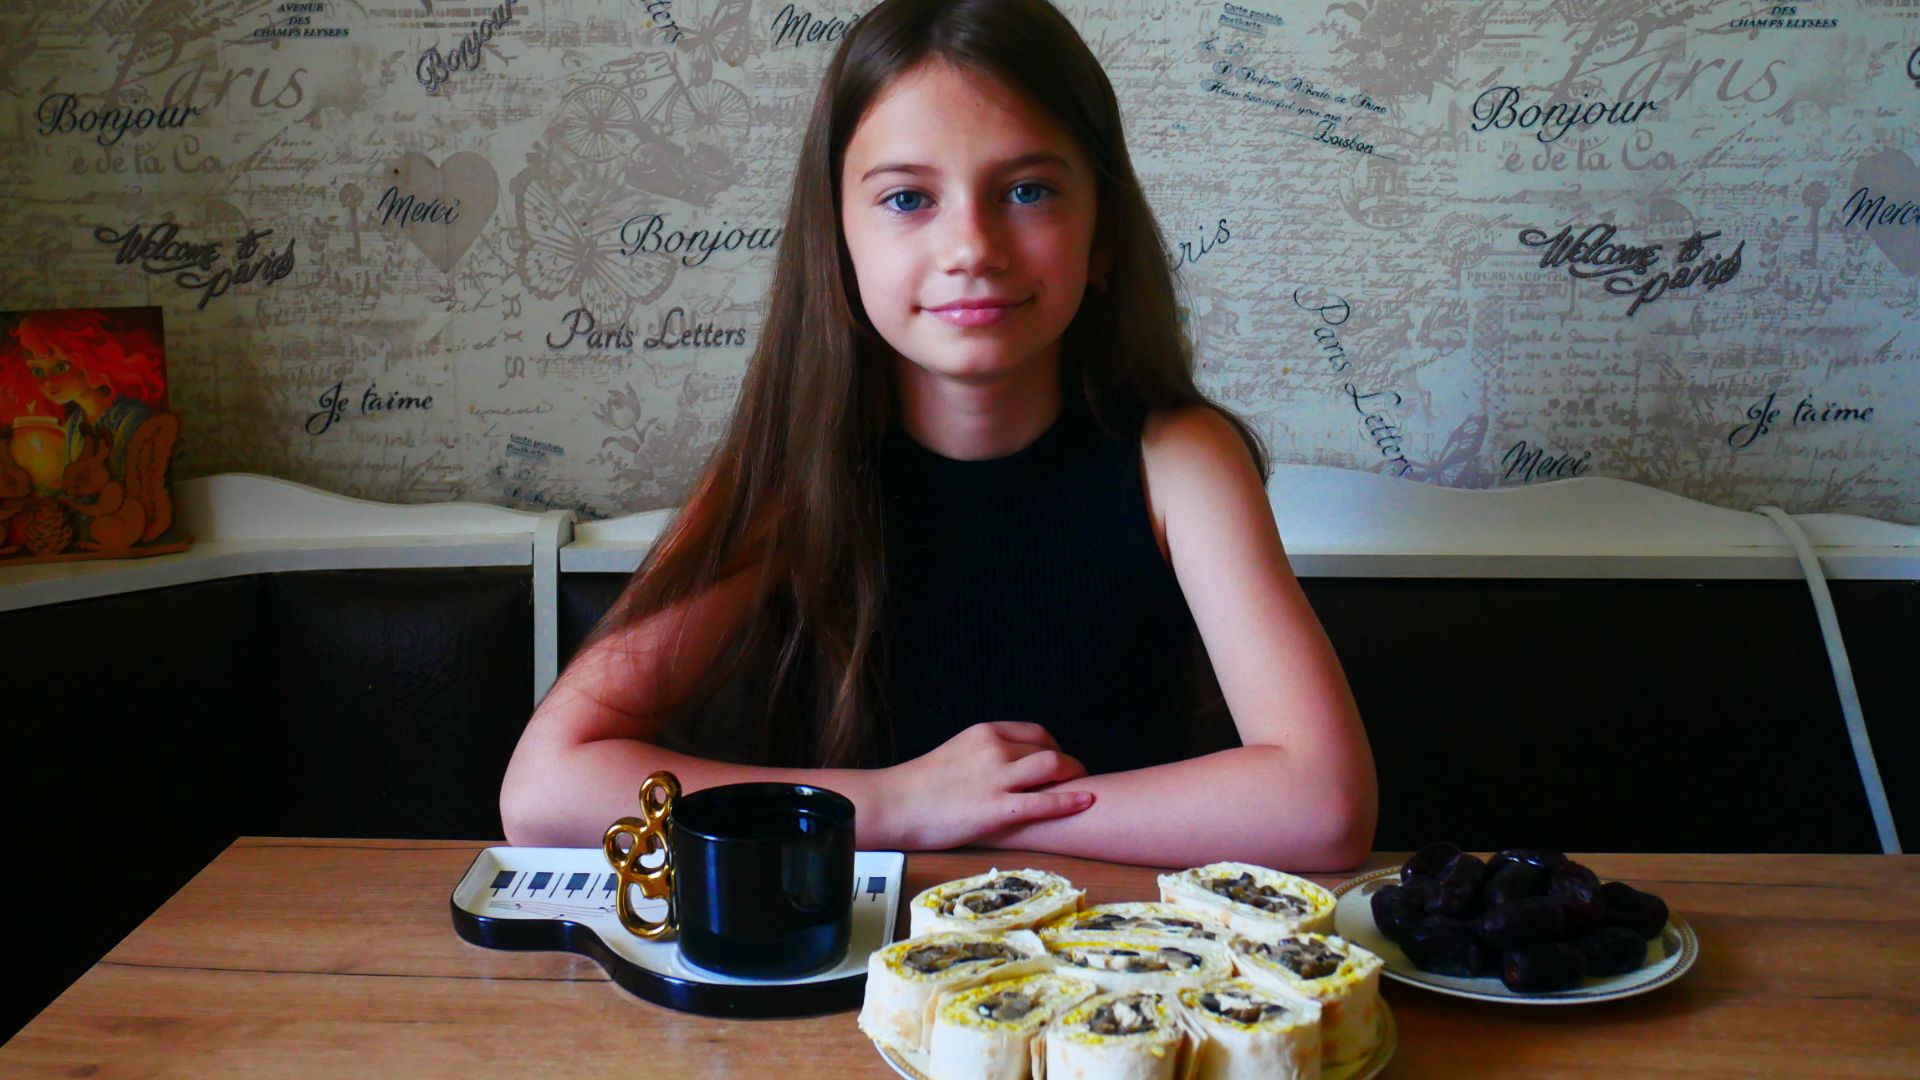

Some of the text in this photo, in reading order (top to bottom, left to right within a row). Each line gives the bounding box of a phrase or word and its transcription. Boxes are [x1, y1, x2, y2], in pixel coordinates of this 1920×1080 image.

[278, 3, 324, 13] AVENUE
[288, 16, 311, 26] DES
[771, 3, 860, 48] Merci
[1729, 19, 1838, 29] CHAMPS ELYSEES
[1771, 6, 1797, 16] DES
[253, 28, 350, 38] CHAMPS ELYSEES
[37, 92, 201, 147] Bonjour
[1471, 86, 1658, 144] Bonjour
[377, 186, 460, 228] Merci
[94, 221, 274, 274] Welcome to
[1518, 223, 1663, 278] Welcome
[1676, 229, 1722, 264] to
[546, 306, 747, 350] Paris Letters
[1294, 287, 1415, 477] Paris Letters
[305, 381, 435, 437] Je t'aime
[1728, 391, 1875, 449] Je t'aime
[1501, 440, 1593, 481] Merci
